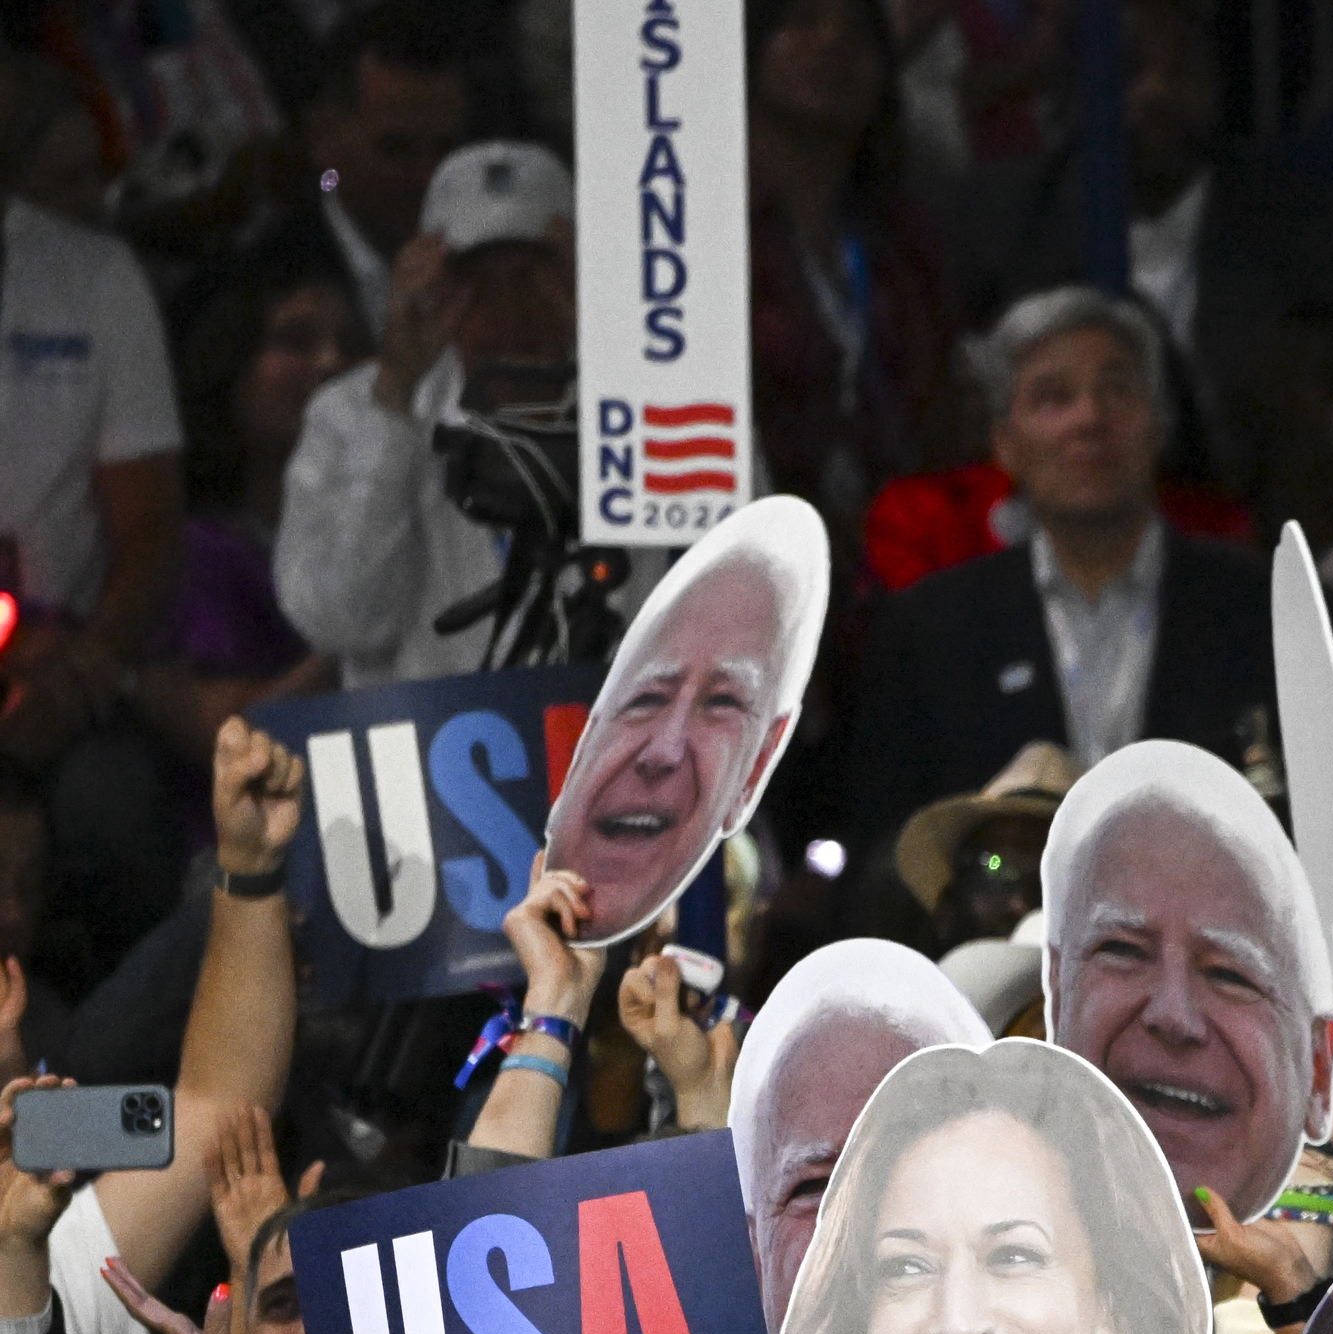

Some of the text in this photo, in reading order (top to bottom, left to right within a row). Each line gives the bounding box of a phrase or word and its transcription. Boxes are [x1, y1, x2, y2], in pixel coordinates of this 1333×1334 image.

[641, 0, 687, 362] SLANDS
[600, 400, 633, 524] DNC
[307, 703, 589, 949] US
